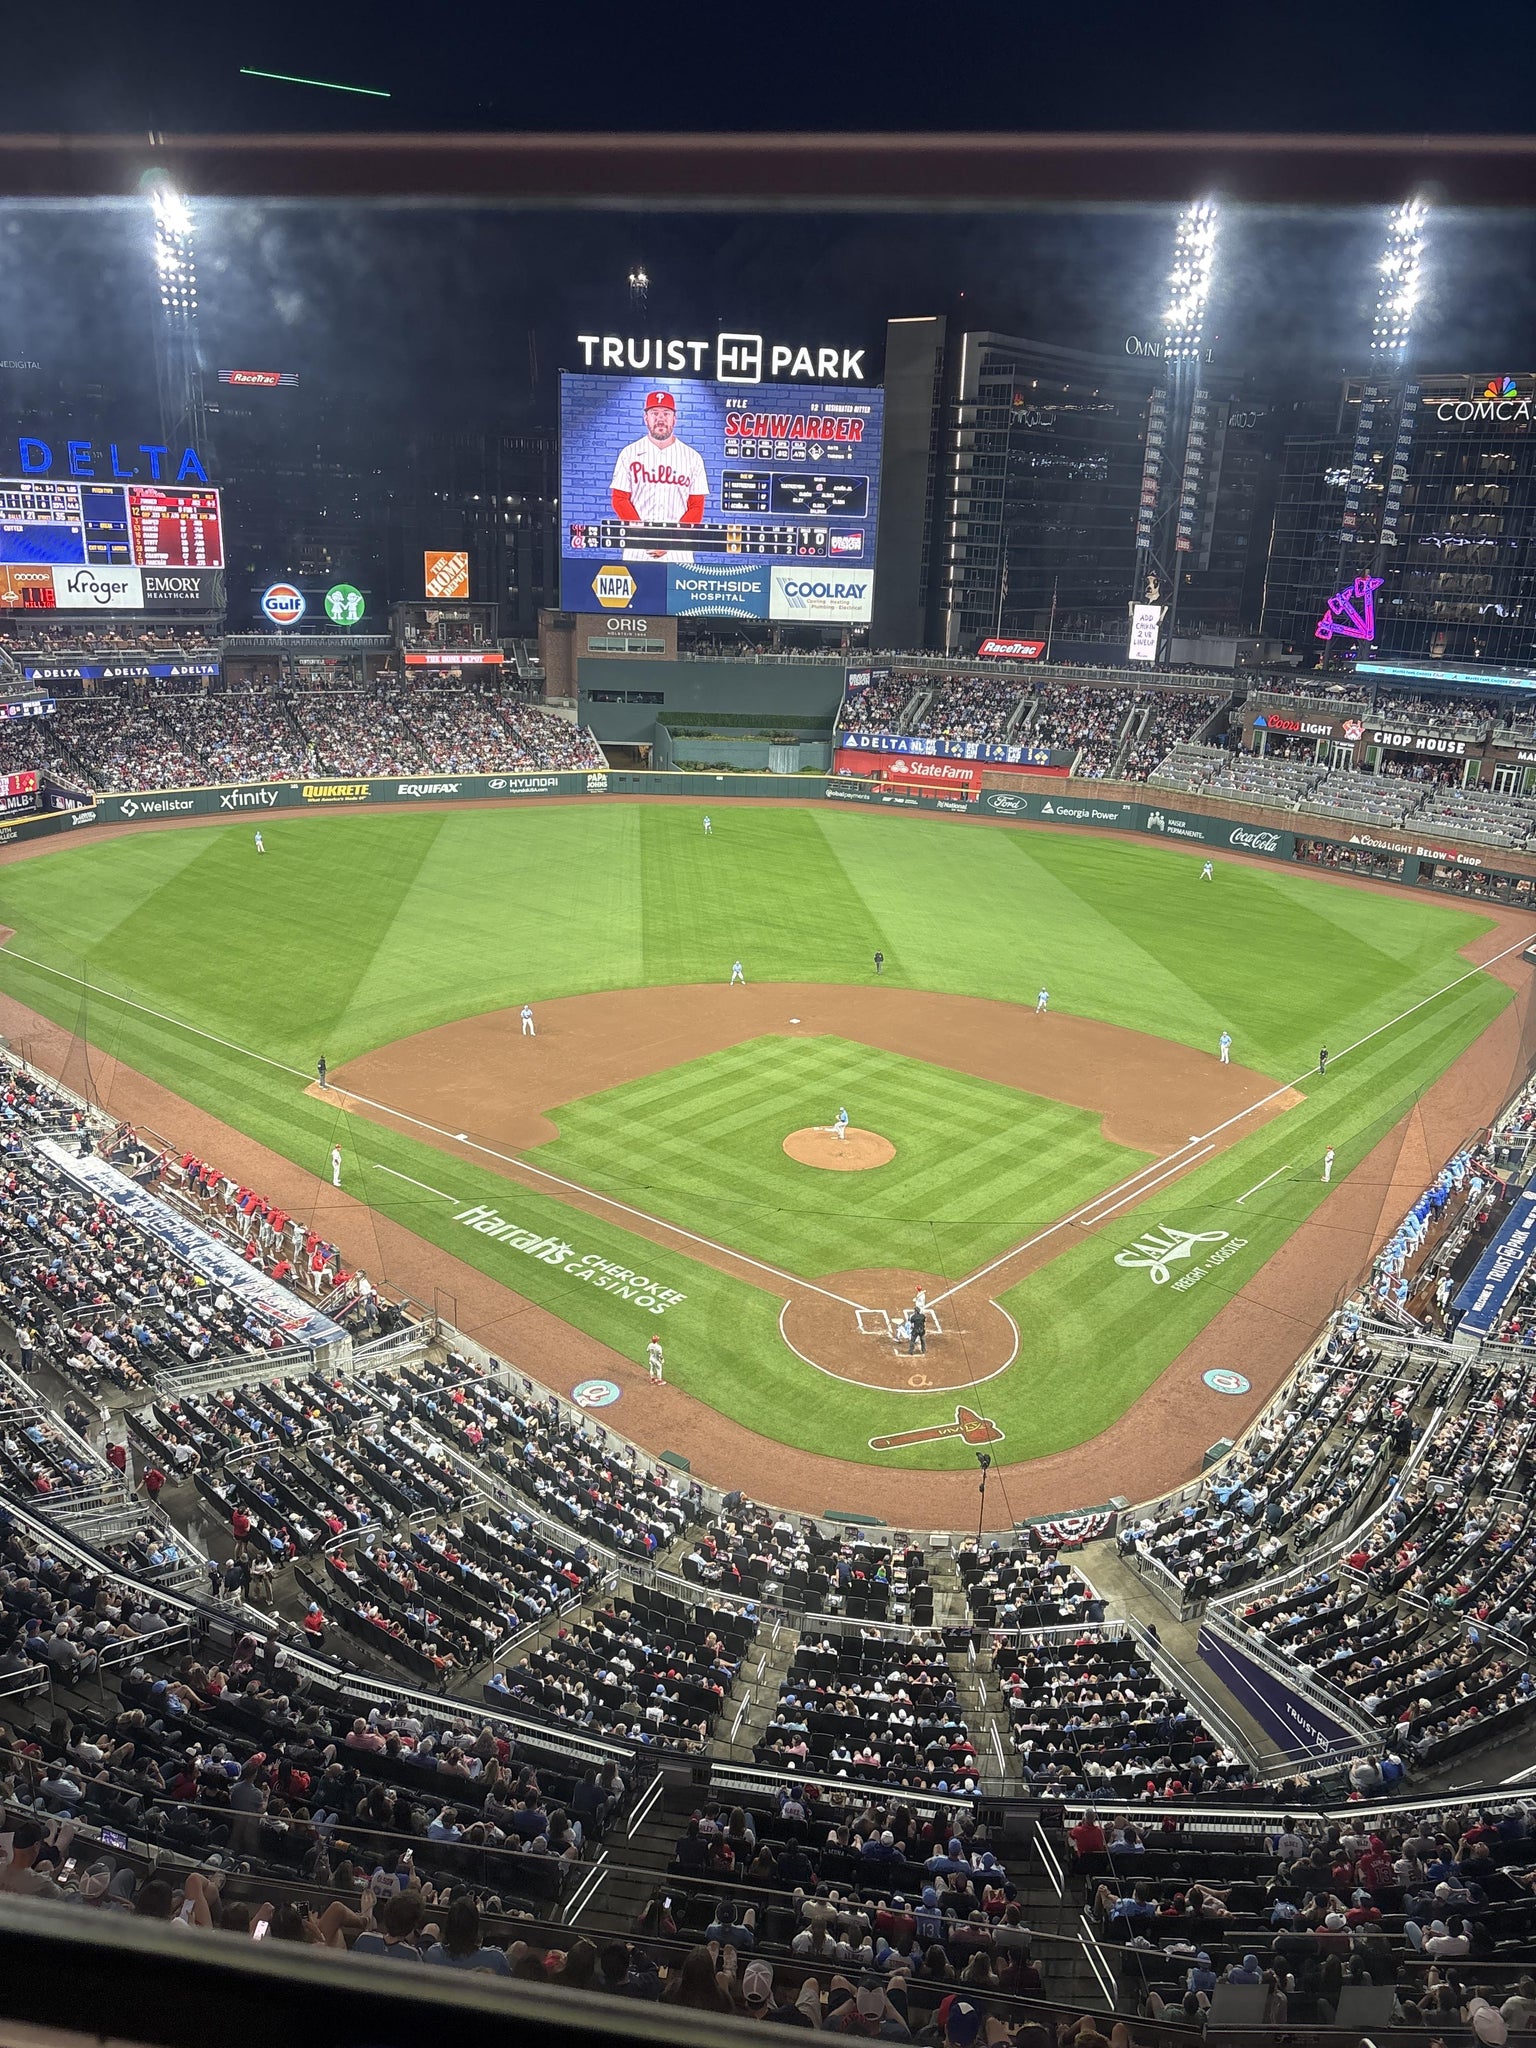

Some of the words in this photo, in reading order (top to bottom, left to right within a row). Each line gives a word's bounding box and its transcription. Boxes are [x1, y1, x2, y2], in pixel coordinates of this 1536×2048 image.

[577, 335, 709, 372] TRUIST
[771, 345, 866, 380] PARK
[234, 373, 275, 384] RaceTrac
[726, 398, 748, 409] KYLE
[1437, 401, 1536, 421] COMCA
[725, 412, 865, 442] SCHWARBER
[19, 437, 209, 482] DELTA
[629, 461, 691, 487] Phillies
[427, 552, 467, 596] HOME
[67, 570, 129, 604] Kroger
[145, 577, 201, 591] EMORY
[599, 577, 630, 596] NAPA
[675, 579, 762, 593] NORTHSIDE
[784, 581, 868, 599] COOLRAY
[265, 597, 302, 611] Gulf
[690, 592, 746, 603] HOSPITAL
[607, 618, 647, 631] ORIS
[983, 642, 1037, 656] RaceTrac
[44, 669, 81, 677] DELTA
[114, 667, 150, 676] DELTA
[181, 666, 214, 674] DELTA
[1267, 714, 1300, 731] Coors
[1300, 723, 1333, 736] LIGHT
[861, 736, 908, 751] DELTA
[1373, 732, 1412, 747] CHOP
[1416, 738, 1466, 755] HOUSE
[509, 777, 559, 788] HYUNDAI
[587, 773, 608, 783] PAPA
[587, 781, 608, 789] JOHNS
[302, 784, 369, 797] QUIKRETE
[397, 783, 459, 797] EQUIFAX
[7, 796, 34, 809] MLB+
[220, 788, 278, 810] xfinity
[994, 795, 1021, 809] Ford
[141, 800, 194, 813] Wellstar
[943, 802, 968, 811] National
[1056, 806, 1089, 819] Georgia
[1092, 811, 1119, 820] Power
[1168, 819, 1186, 828] KAISER
[1361, 834, 1387, 849] Coors
[1387, 842, 1413, 854] LIGHT
[1416, 847, 1447, 861] BELOW
[1456, 854, 1482, 867] CHOP
[1486, 1255, 1514, 1282] TRUIST
[1507, 1229, 1531, 1249] PARK
[1171, 1266, 1208, 1292] FREIGHT
[1209, 1237, 1249, 1266] LOGISTICS
[581, 1254, 688, 1306] CHEROKEE
[563, 1263, 670, 1314] CASINOS
[1286, 1702, 1317, 1737] TRUIST
[1375, 1868, 1392, 1885] 13
[922, 1923, 935, 1937] 13
